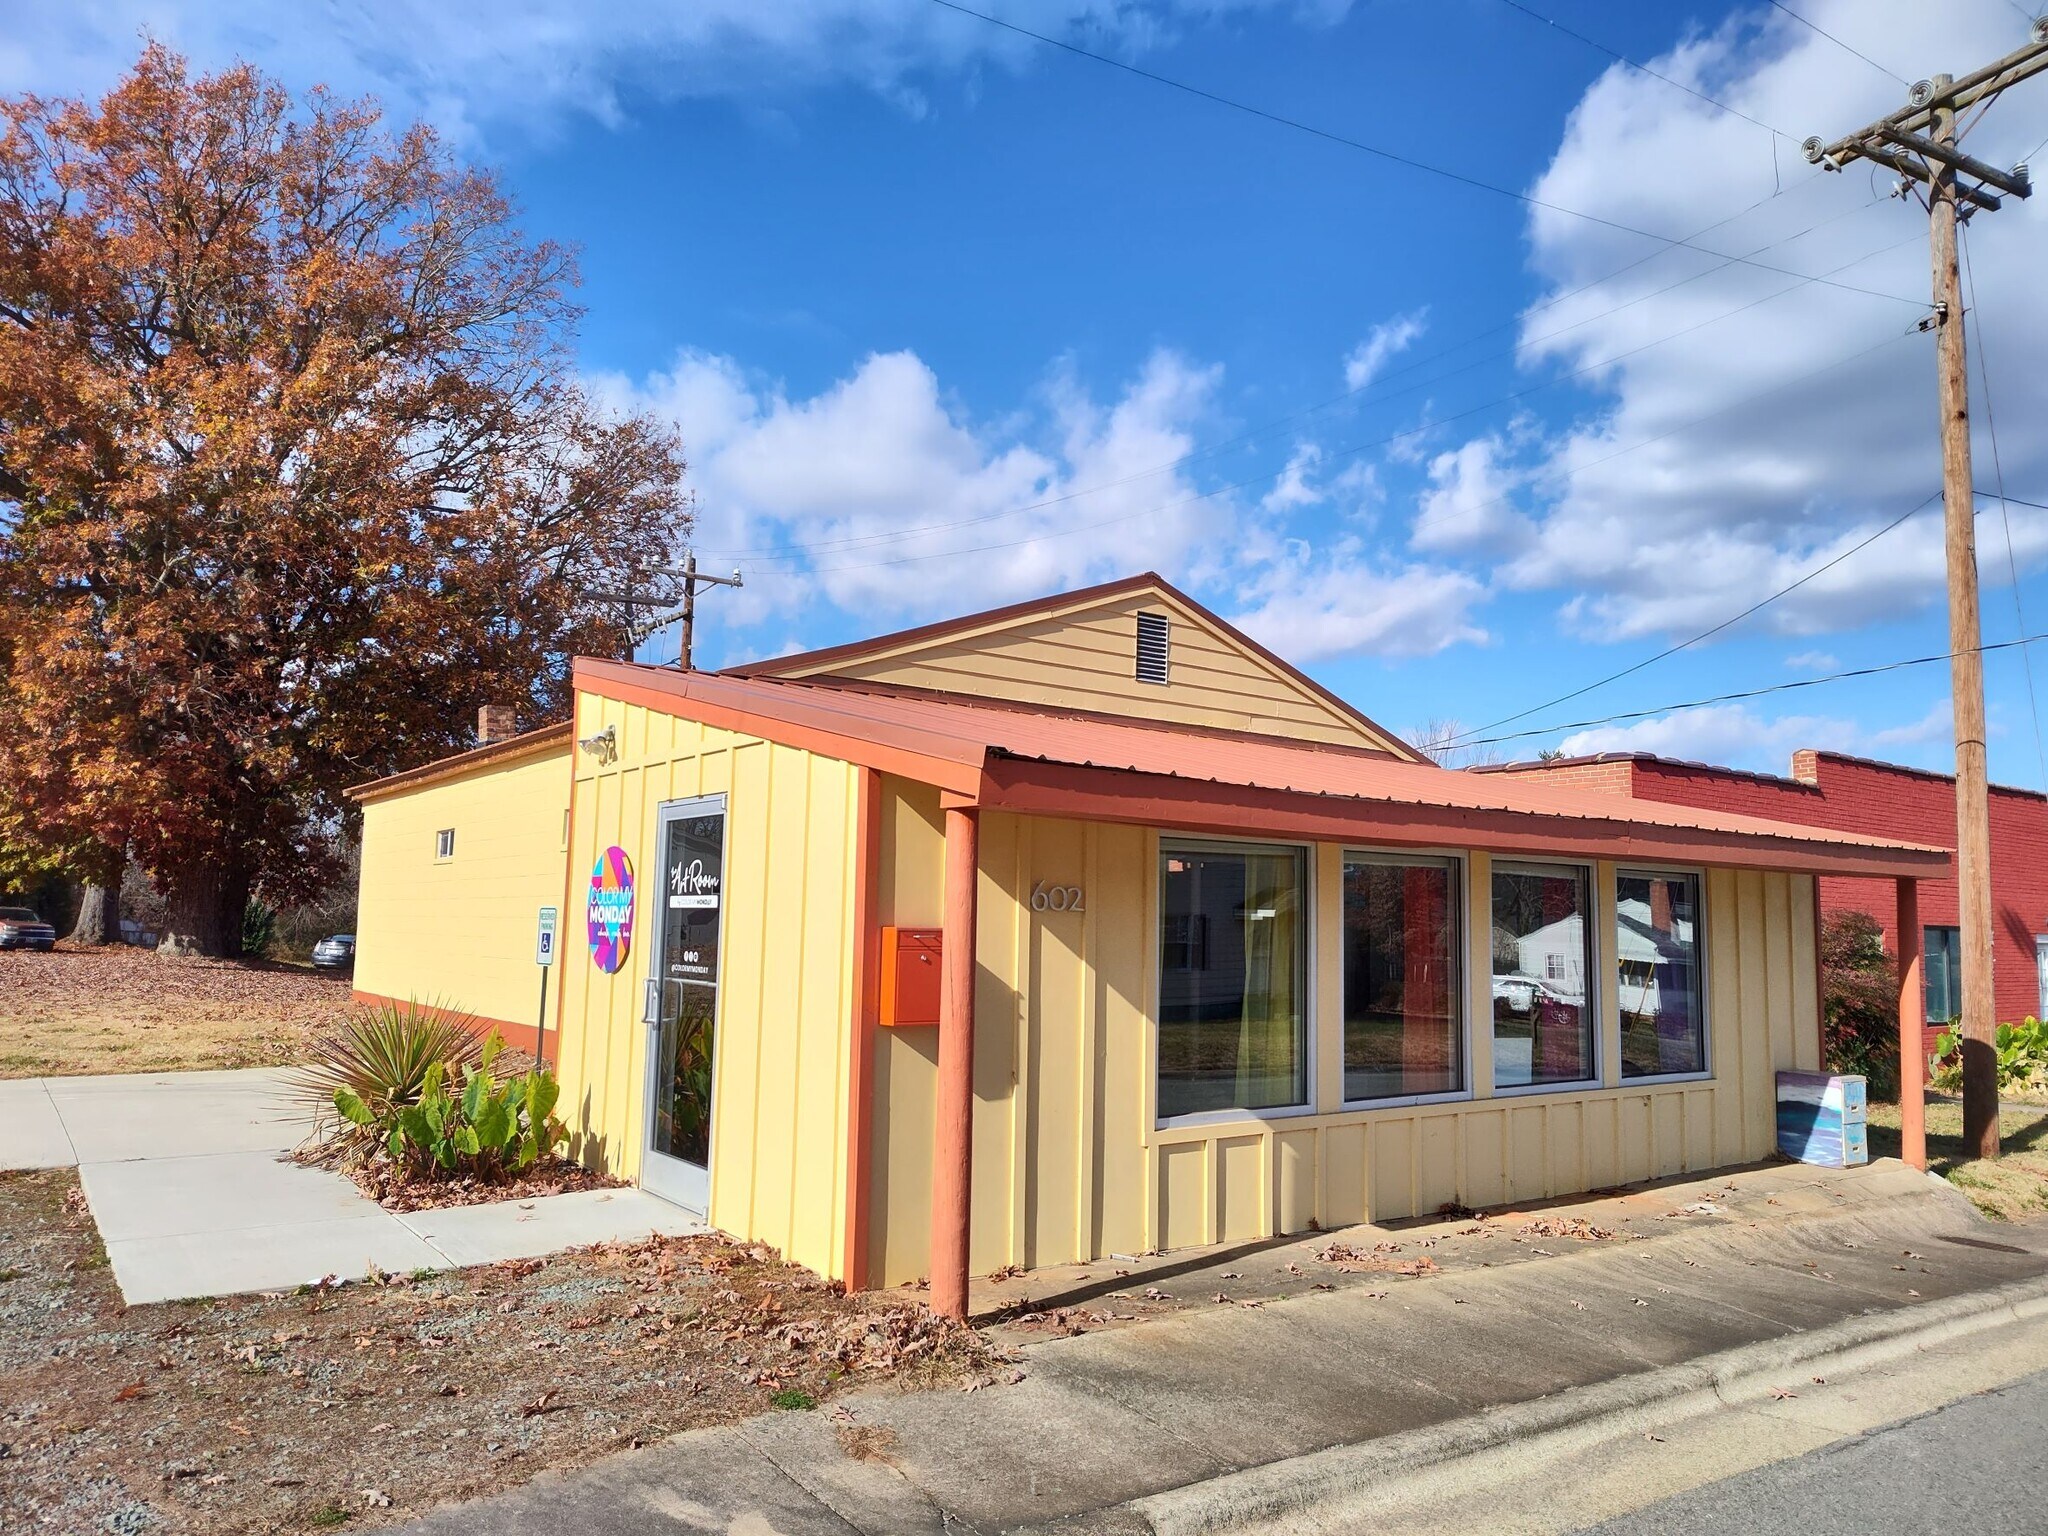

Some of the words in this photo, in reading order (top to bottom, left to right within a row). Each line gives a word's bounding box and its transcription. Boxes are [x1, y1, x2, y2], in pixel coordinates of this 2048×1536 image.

[671, 861, 690, 895] Art
[689, 859, 720, 895] Room
[590, 886, 620, 905] COLOR
[620, 885, 633, 906] MY
[1031, 879, 1086, 912] 602
[589, 905, 633, 924] MONDAY
